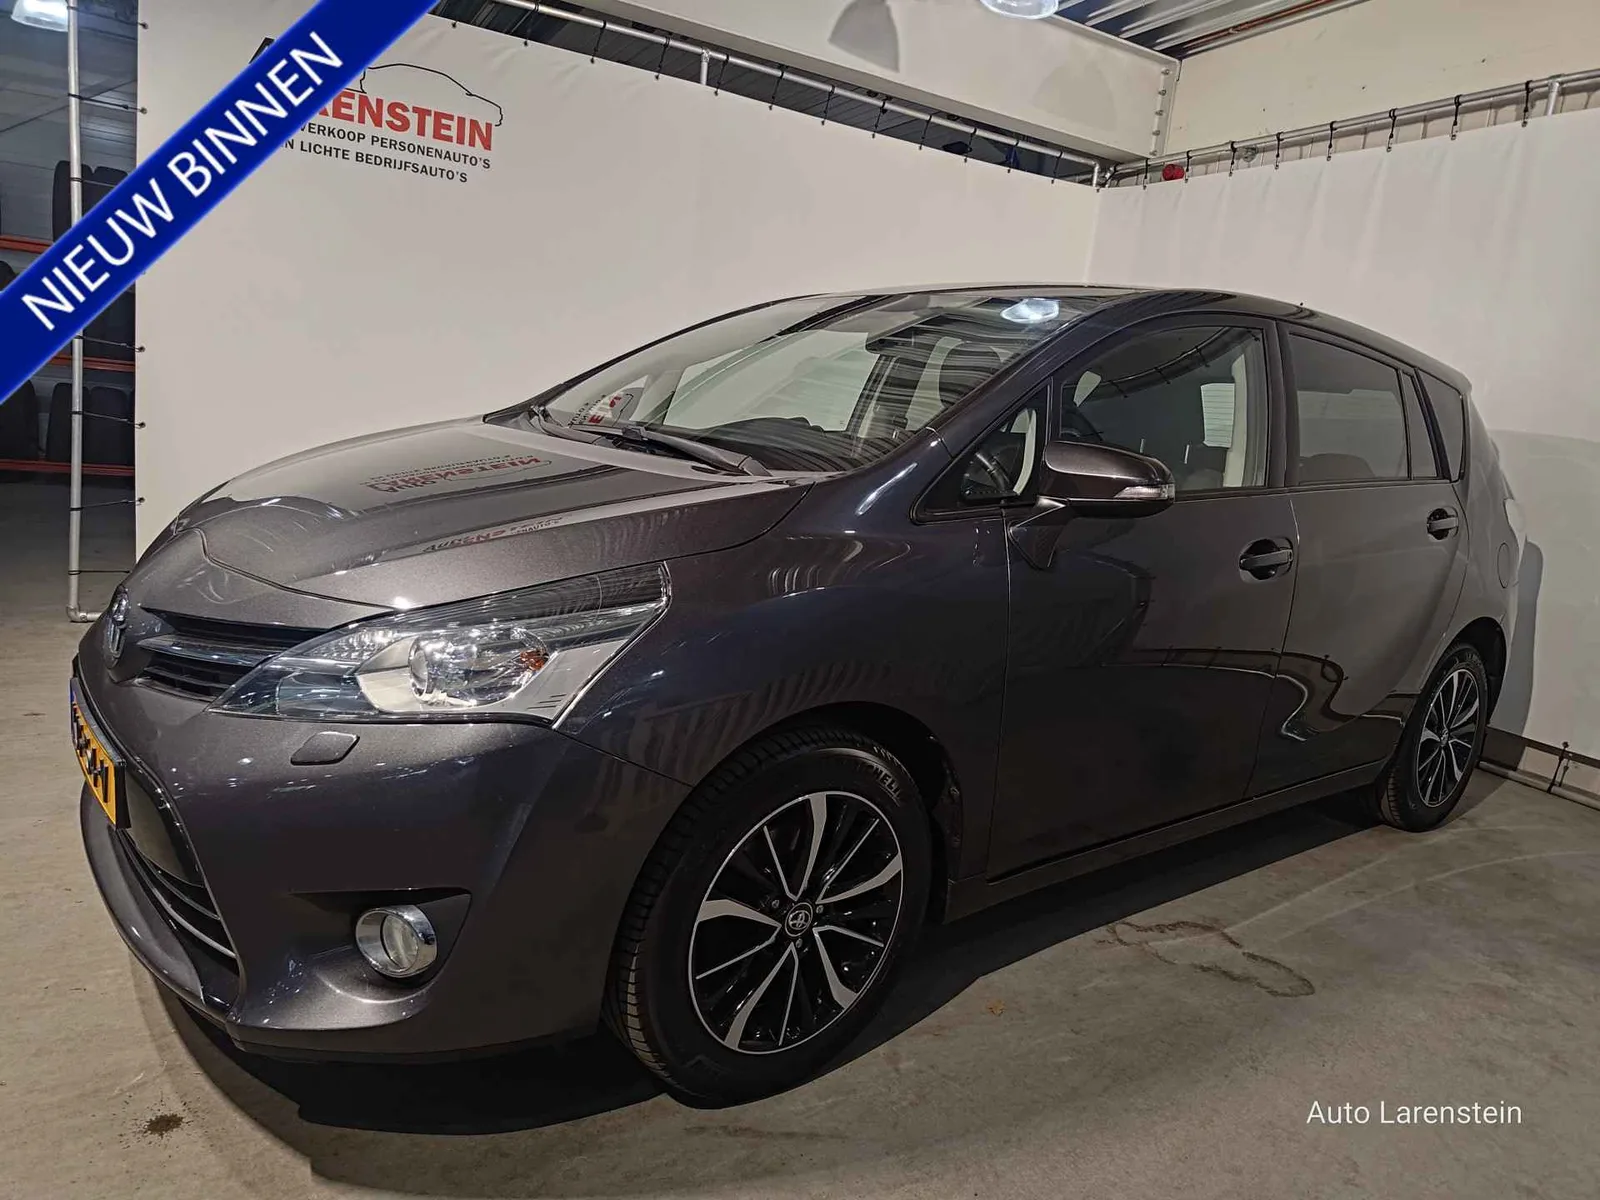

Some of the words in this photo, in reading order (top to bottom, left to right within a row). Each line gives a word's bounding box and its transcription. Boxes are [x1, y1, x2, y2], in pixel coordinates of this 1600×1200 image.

[318, 91, 493, 151] ENSTEIN
[300, 140, 350, 160] LICHTE
[355, 151, 468, 183] BEDRIJFSAUTO'S
[371, 135, 491, 169] PERSONENAUTO'S
